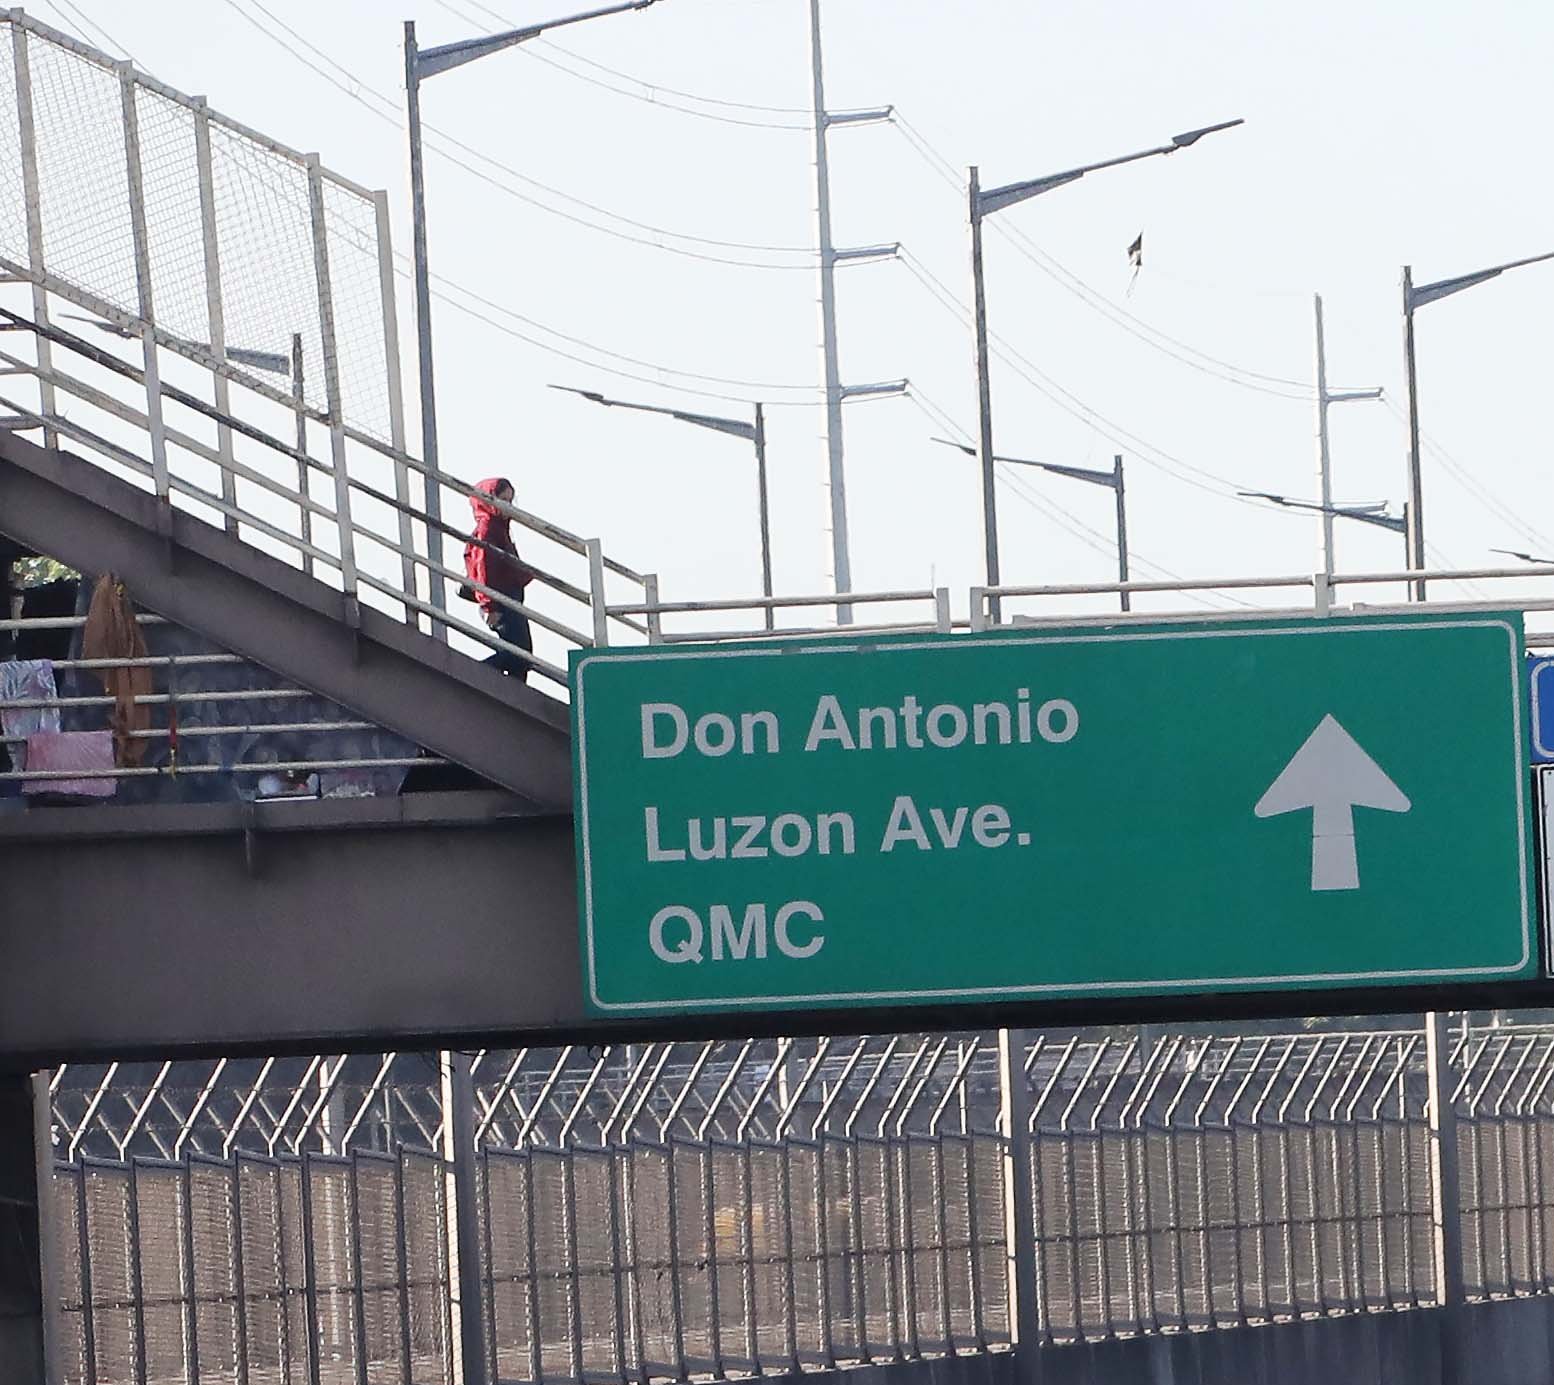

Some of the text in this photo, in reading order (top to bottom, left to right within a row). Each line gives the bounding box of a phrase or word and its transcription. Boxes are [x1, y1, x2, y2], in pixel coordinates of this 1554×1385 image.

[640, 688, 1080, 758] Don Antonio
[645, 796, 1034, 864] Luzon Ave.
[648, 898, 827, 966] QMC
